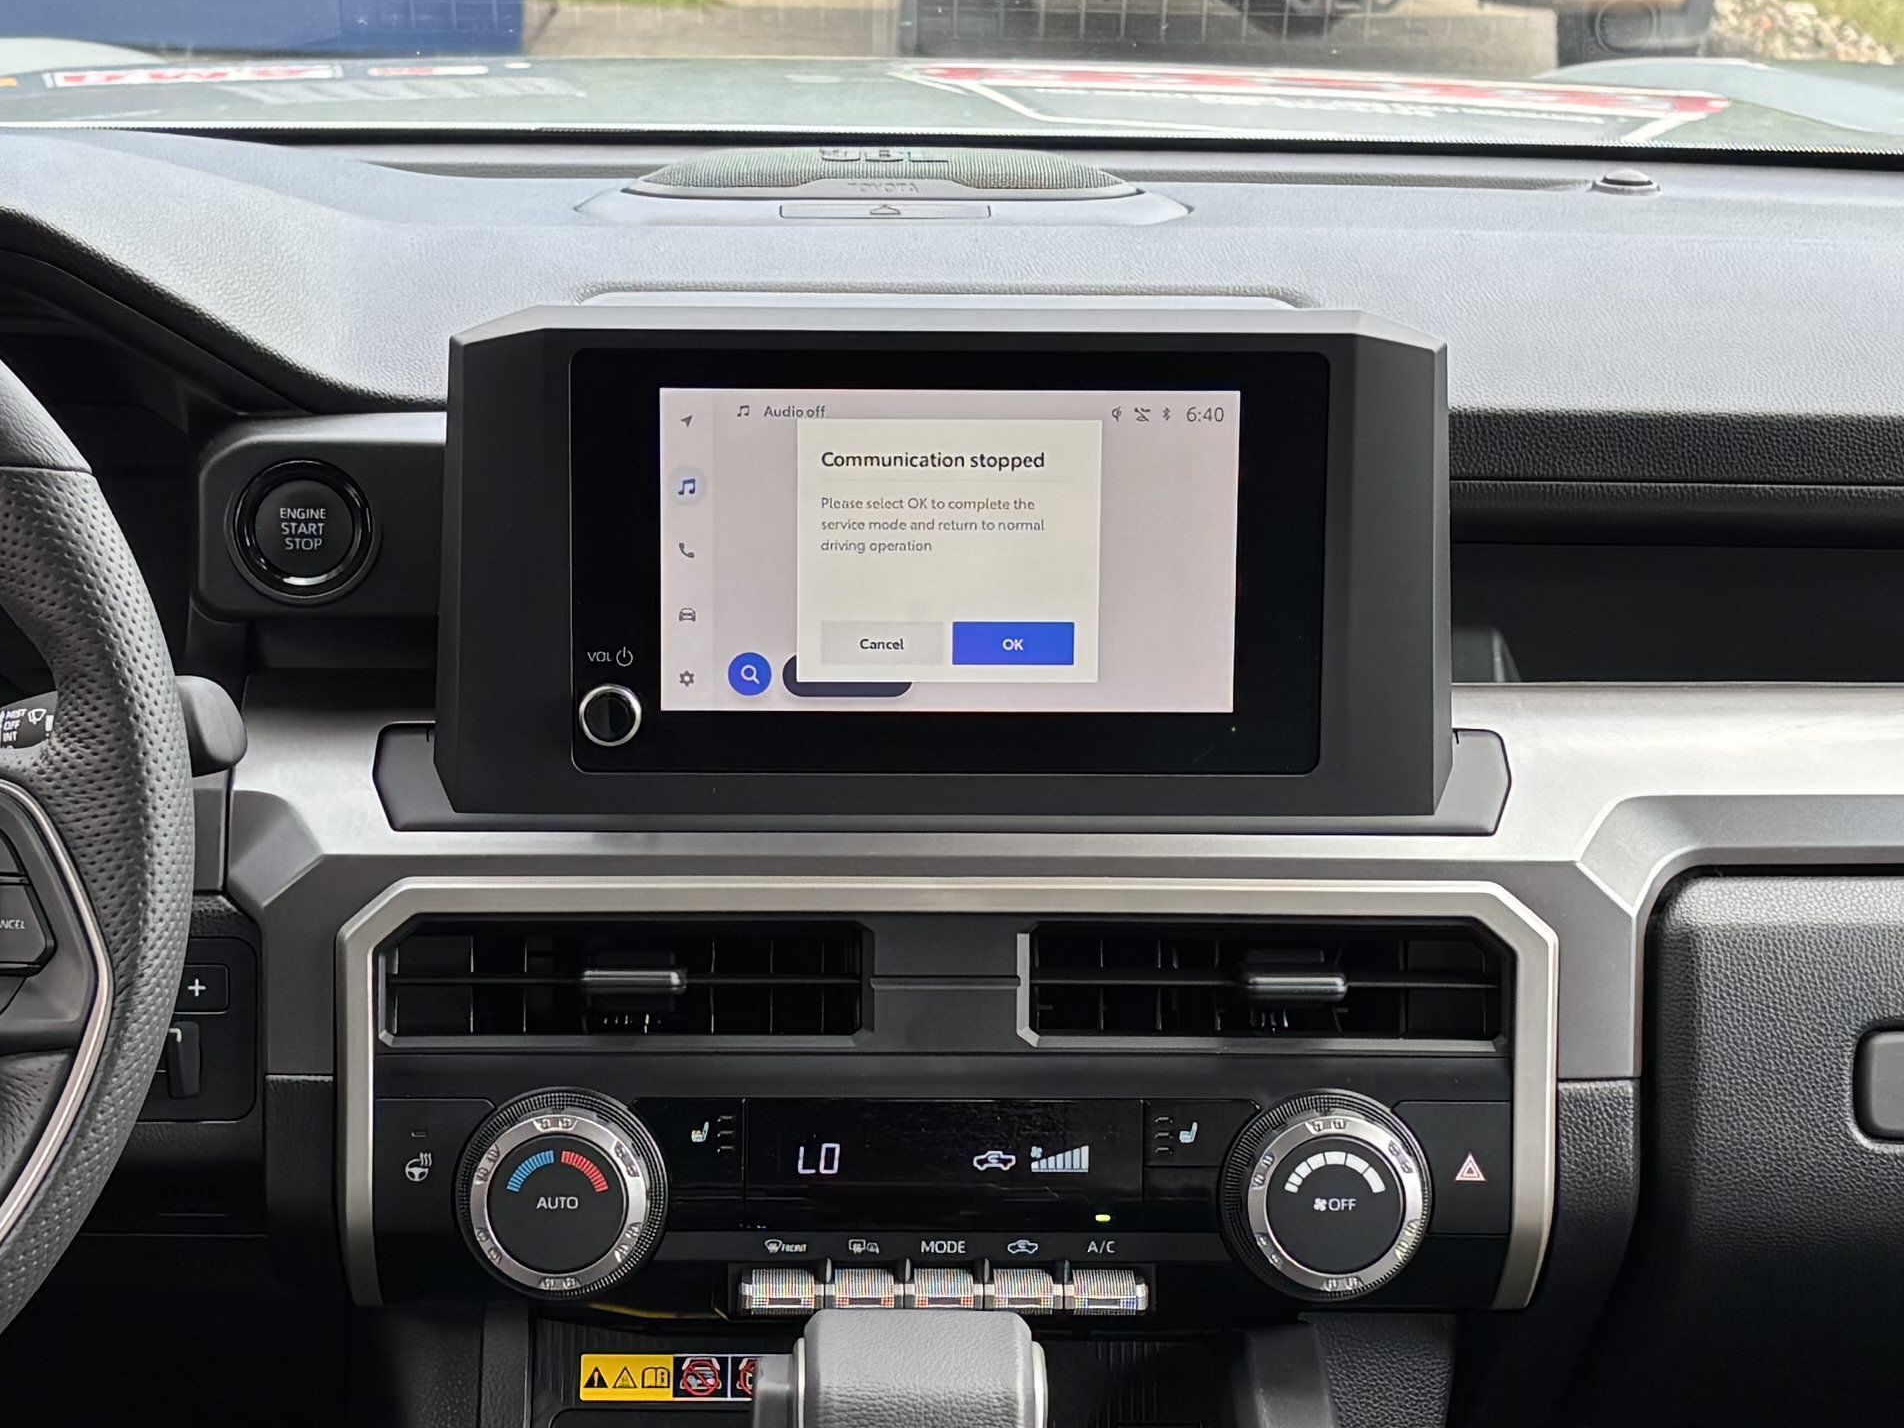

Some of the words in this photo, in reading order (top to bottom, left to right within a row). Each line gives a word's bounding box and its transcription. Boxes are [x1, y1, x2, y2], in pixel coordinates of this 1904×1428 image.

[846, 181, 920, 193] TOYOTA
[763, 404, 805, 419] Audio
[805, 404, 826, 419] off
[1186, 406, 1225, 423] 6:40
[821, 451, 966, 469] Communication
[969, 451, 1046, 472] stopped
[821, 497, 864, 511] Please
[866, 497, 904, 511] select
[907, 497, 929, 510] OK
[930, 498, 946, 511] to
[947, 497, 1011, 513] complete
[1013, 497, 1036, 511] the
[279, 507, 327, 520] ENGINE
[281, 522, 325, 536] START
[821, 518, 866, 532] service
[868, 517, 907, 532] mode
[909, 517, 935, 532] and
[937, 519, 978, 532] return
[981, 519, 996, 532] to
[997, 518, 1045, 532] normal
[284, 537, 323, 551] STOP
[821, 539, 866, 554] driving
[869, 539, 933, 554] operation
[859, 637, 905, 651] Cancel
[1002, 638, 1025, 652] OK
[536, 1195, 580, 1210] AUTO
[1328, 1197, 1357, 1212] OFF
[920, 1239, 966, 1254] MODE
[1086, 1240, 1116, 1254] A/C
